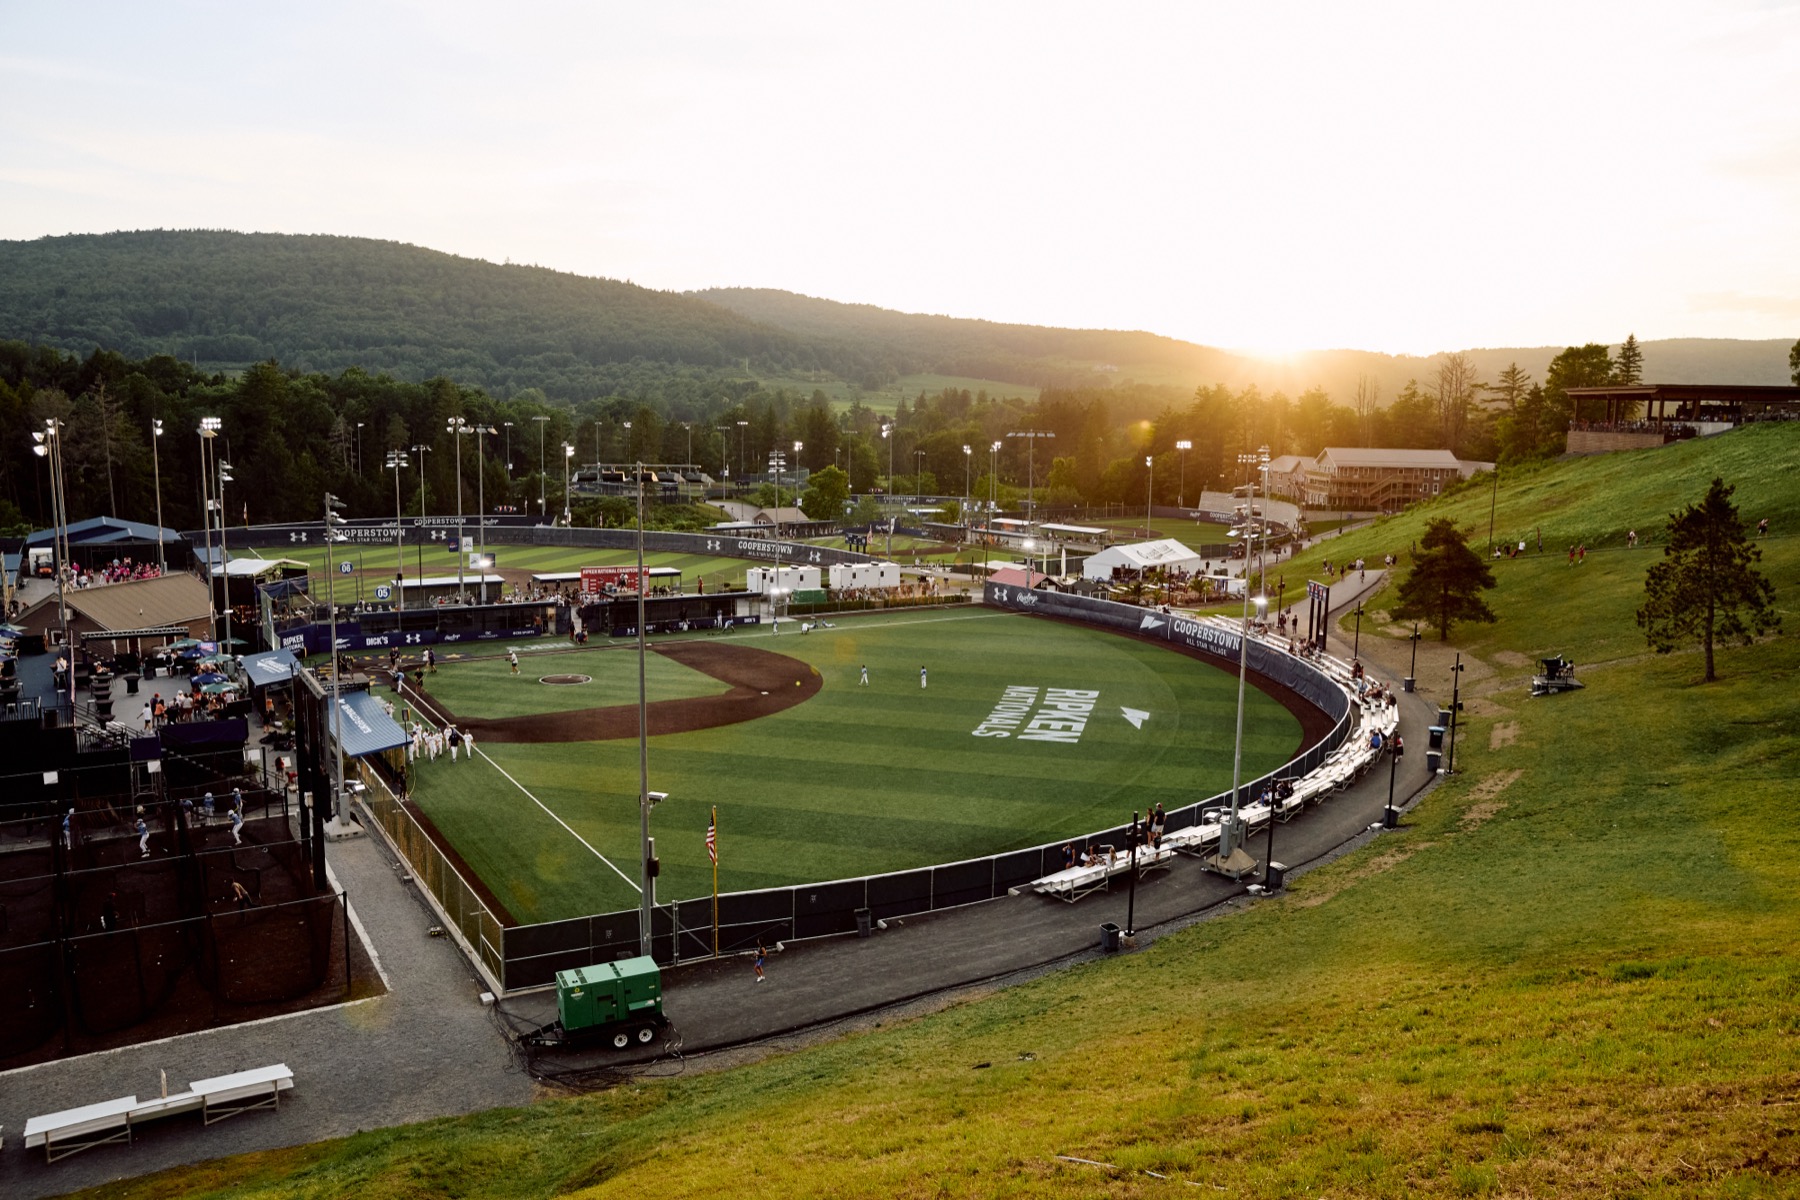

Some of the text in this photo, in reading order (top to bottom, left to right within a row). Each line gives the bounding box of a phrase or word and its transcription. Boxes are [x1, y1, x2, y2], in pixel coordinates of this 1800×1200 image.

[738, 541, 793, 555] COOPERSTOWN
[378, 588, 388, 598] 05
[282, 634, 304, 647] RIPKEN
[366, 636, 388, 646] DICK'S
[1174, 620, 1241, 651] COOPERSTOWN
[972, 685, 1040, 738] NATIONALS
[1017, 688, 1100, 743] RIPKEN
